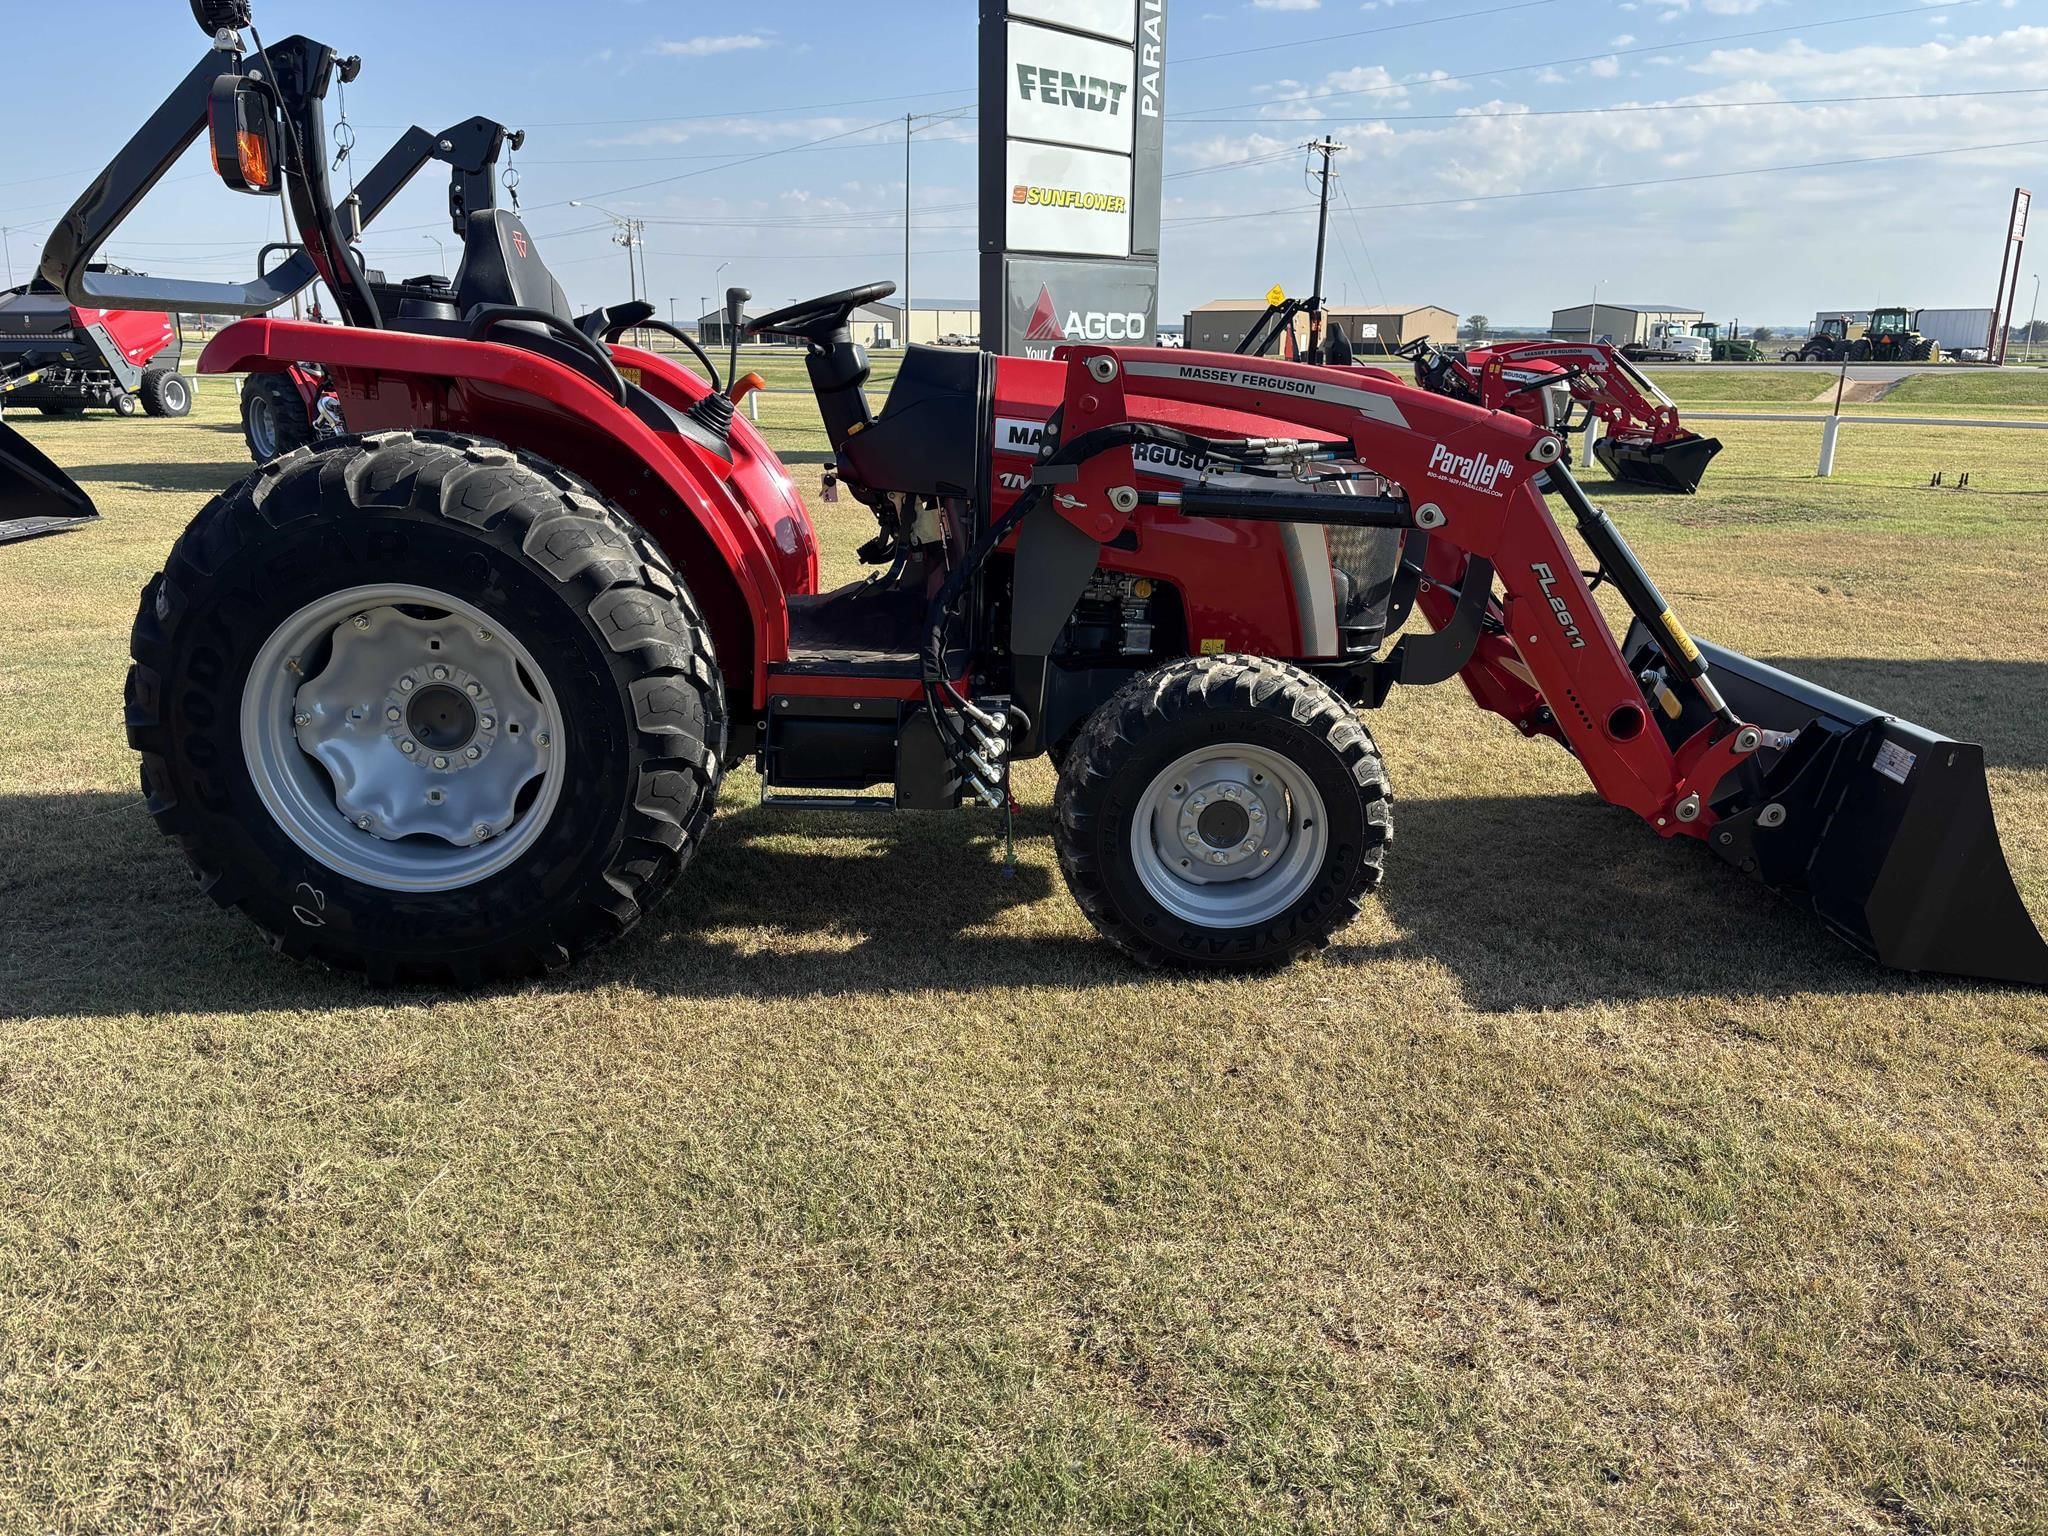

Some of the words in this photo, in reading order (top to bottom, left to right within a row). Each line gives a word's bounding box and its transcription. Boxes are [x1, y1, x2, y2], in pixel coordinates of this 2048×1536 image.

[1016, 62, 1127, 116] FENDT
[1026, 187, 1125, 213] SUNFLOWER
[1063, 310, 1146, 340] AGCO
[1025, 346, 1048, 360] Your
[1524, 349, 1549, 357] MASSEY
[1550, 348, 1582, 356] FERGUSON
[1179, 366, 1237, 385] MASSEY
[1241, 374, 1316, 396] FERGUSON
[1428, 443, 1502, 490] Parallel
[1500, 458, 1514, 479] Ag
[1530, 561, 1587, 649] FL.2611
